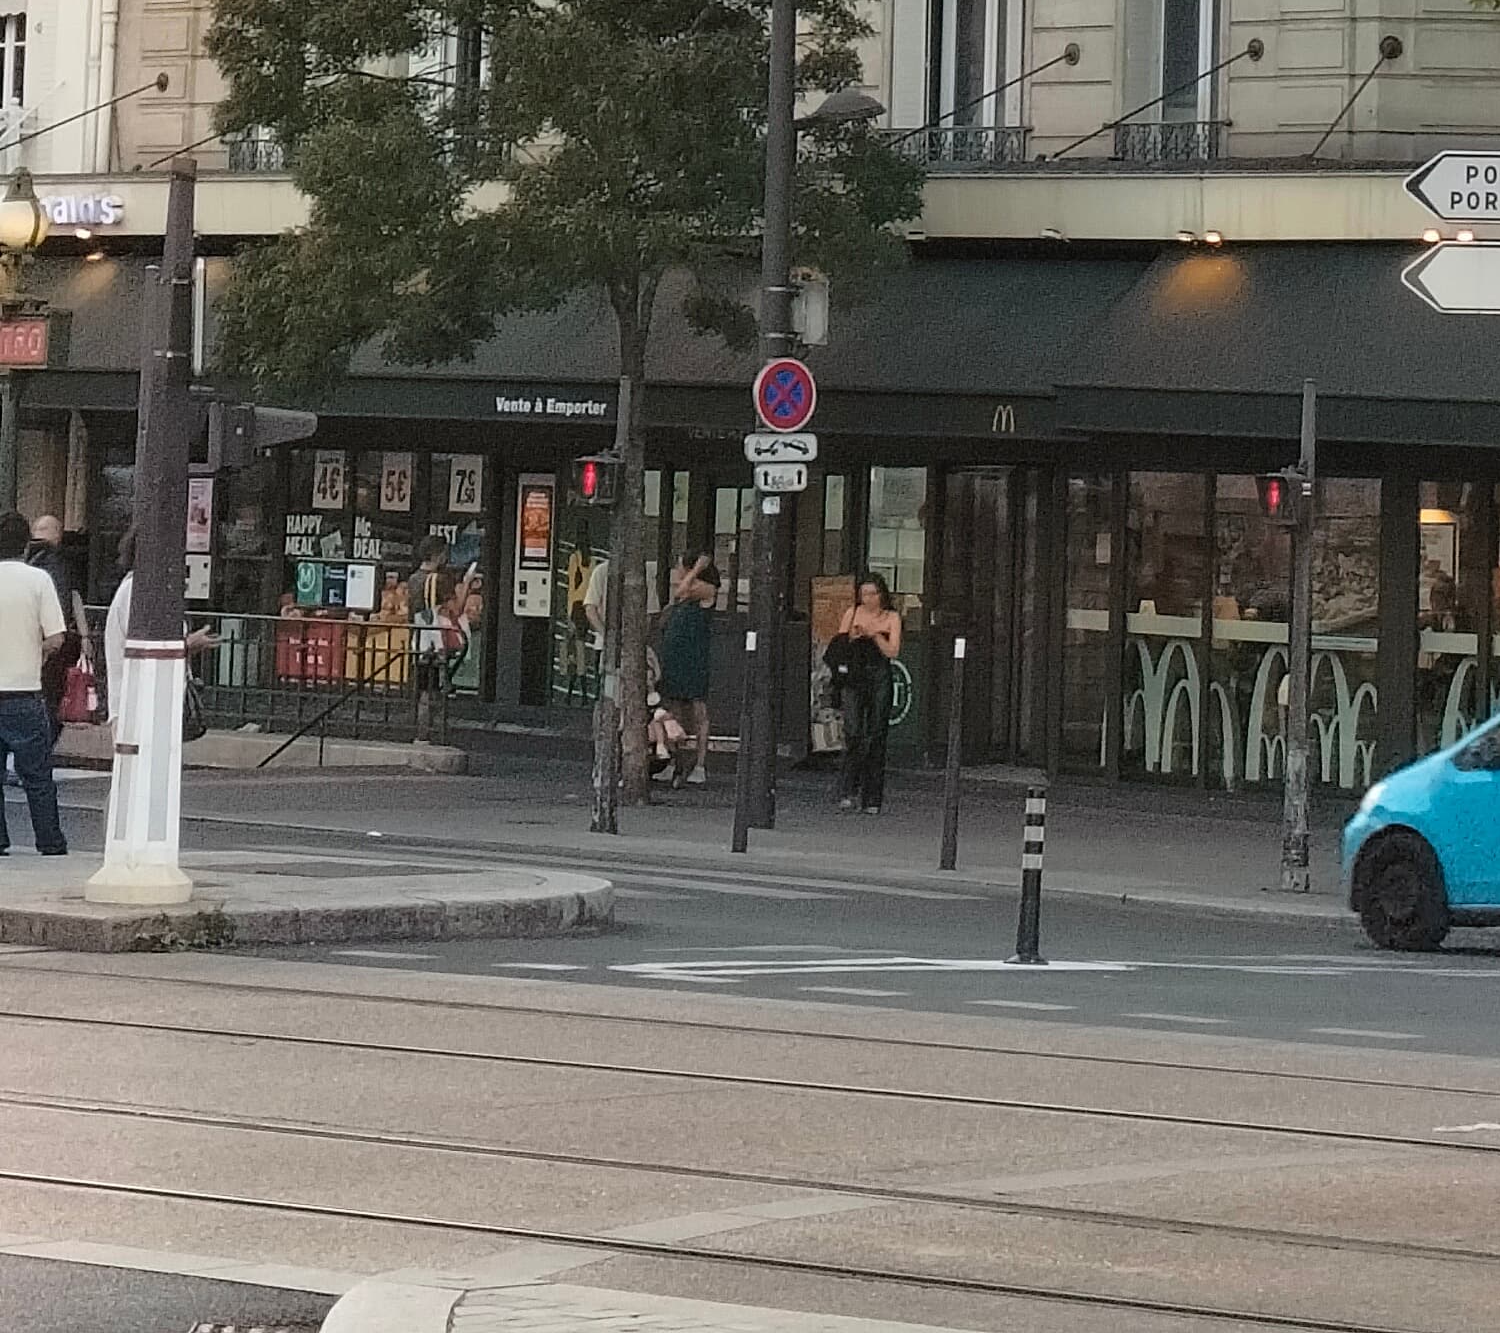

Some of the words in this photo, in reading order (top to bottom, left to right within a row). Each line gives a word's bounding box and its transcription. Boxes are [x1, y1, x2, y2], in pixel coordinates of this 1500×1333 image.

[496, 397, 531, 413] Vente
[534, 397, 543, 413] à
[546, 398, 607, 416] Emporter
[286, 515, 323, 534] HAPPY
[355, 517, 371, 536] Mc
[285, 536, 315, 555] MEAL
[353, 538, 382, 559] DEAL
